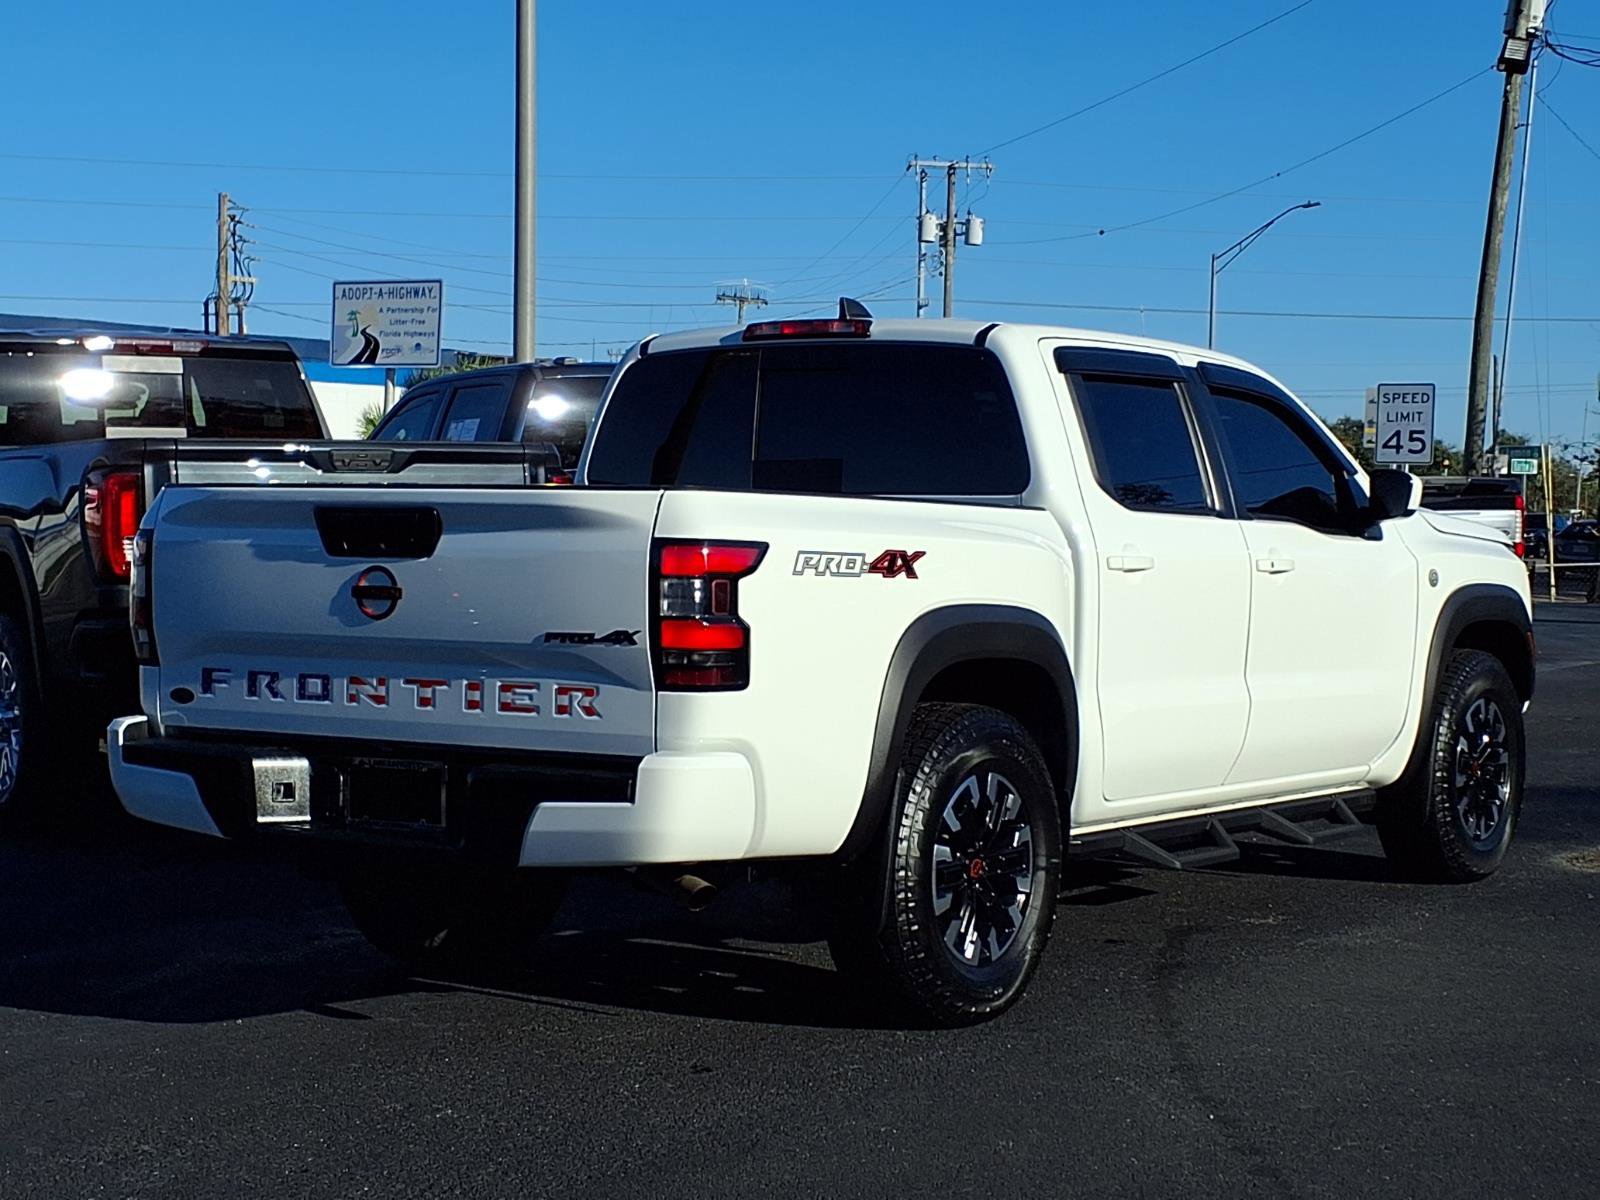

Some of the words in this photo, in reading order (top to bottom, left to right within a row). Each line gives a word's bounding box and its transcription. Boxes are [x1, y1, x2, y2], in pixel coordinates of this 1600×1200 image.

[386, 306, 425, 314] Partnership
[389, 318, 426, 326] Litter-Free
[403, 331, 435, 339] Highways
[1382, 392, 1430, 404] SPEED
[1386, 411, 1424, 423] LIMIT
[1381, 429, 1427, 455] 45
[792, 549, 927, 579] PRO-4X
[201, 666, 604, 719] FRONTIER
